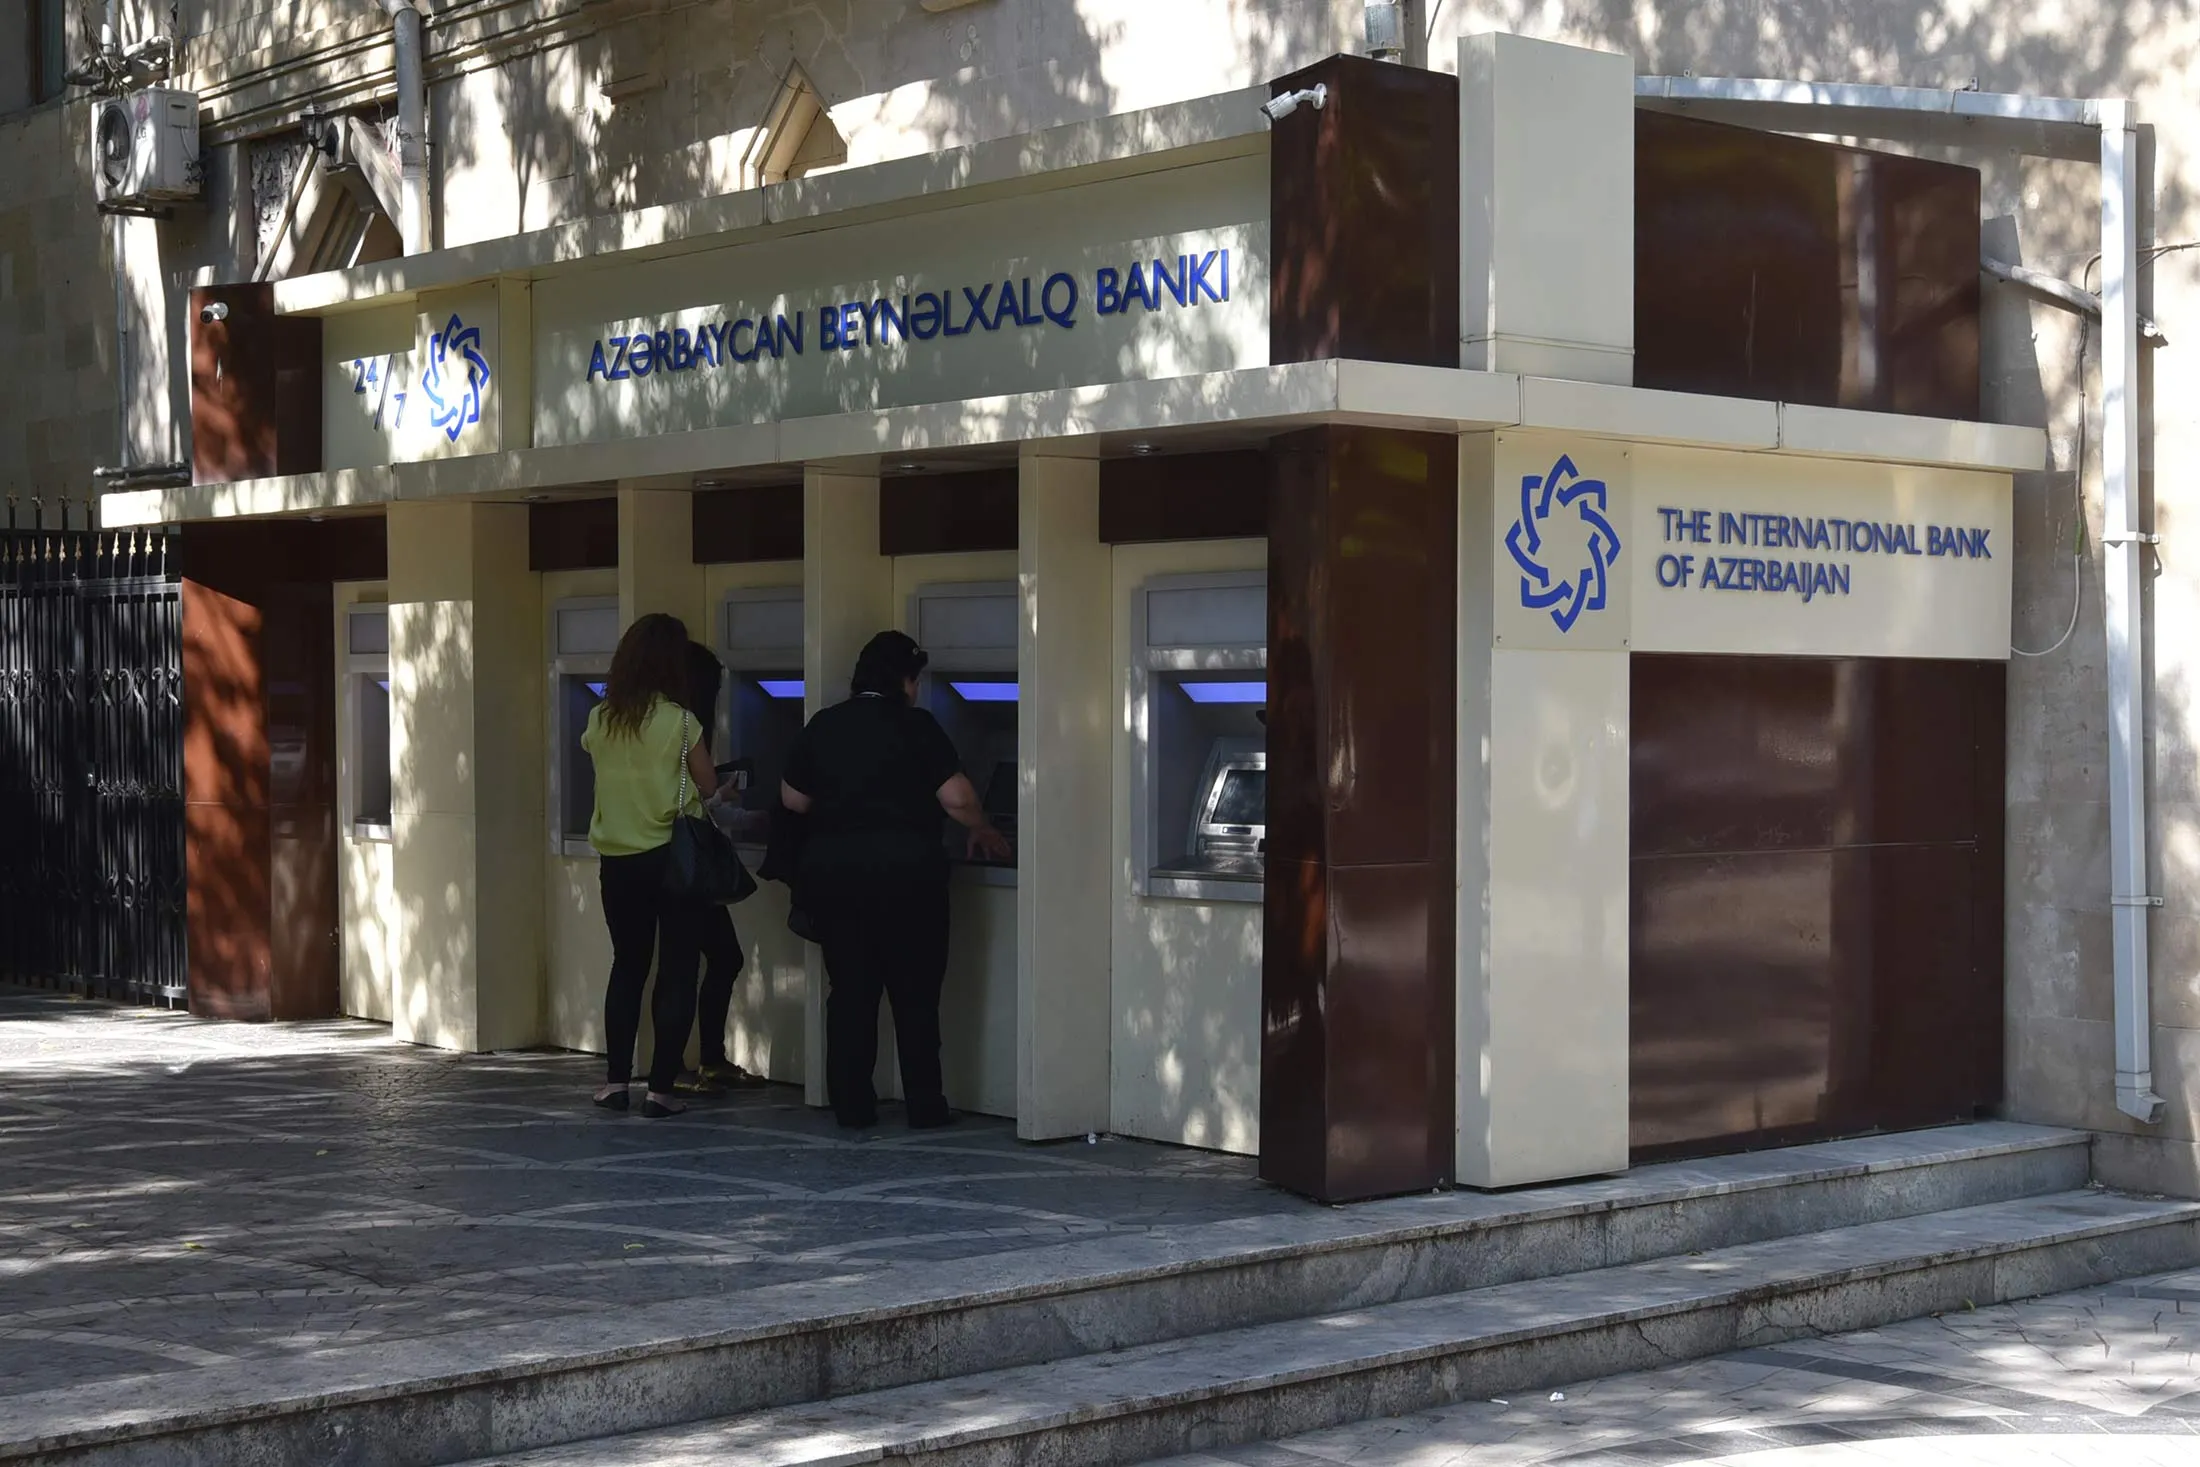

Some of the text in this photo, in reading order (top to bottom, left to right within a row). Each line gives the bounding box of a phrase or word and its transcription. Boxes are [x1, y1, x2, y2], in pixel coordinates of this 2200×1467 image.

[586, 249, 1230, 382] AZƏRBAYCAN BEYNƏLXALQ BANKI
[1657, 506, 1992, 559] THE INTERNATIONAL BANK
[1656, 553, 1850, 603] OF AZERBAIJAN
